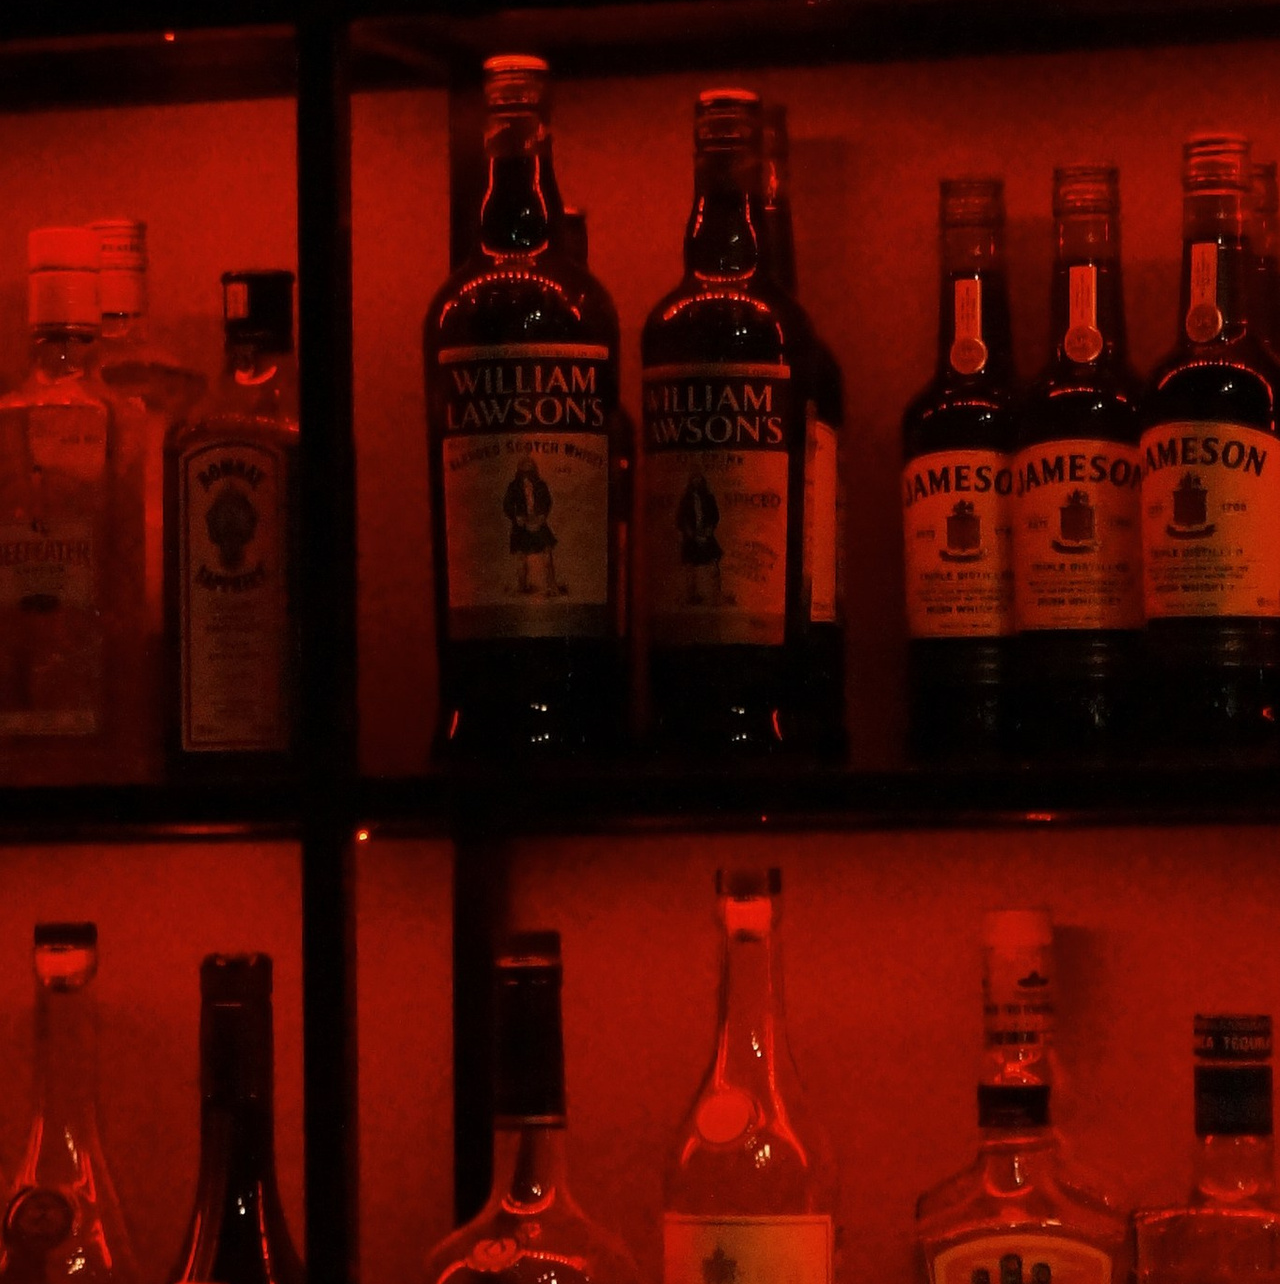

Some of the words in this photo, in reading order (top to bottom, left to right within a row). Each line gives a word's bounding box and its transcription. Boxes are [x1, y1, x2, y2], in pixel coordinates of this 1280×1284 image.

[451, 365, 596, 396] WILLIAM
[446, 396, 605, 430] LAWSON'S
[505, 440, 559, 454] SCOTCH
[1143, 437, 1267, 477] AMESON
[904, 464, 1013, 508] JAMESO
